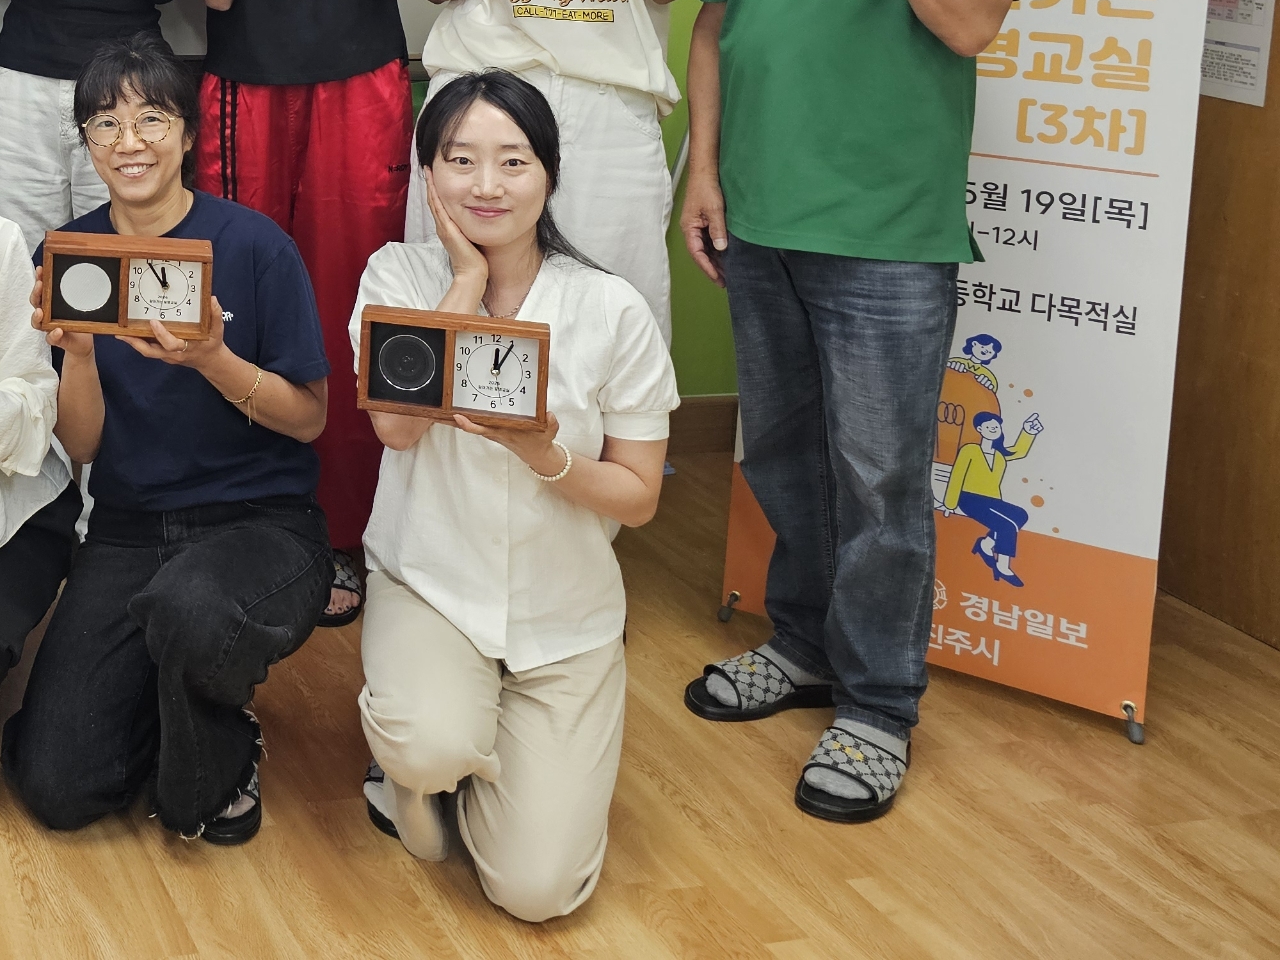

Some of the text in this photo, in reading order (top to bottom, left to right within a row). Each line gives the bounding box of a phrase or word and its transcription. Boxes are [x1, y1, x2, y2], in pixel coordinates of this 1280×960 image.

[976, 27, 1153, 92] 명교실
[1016, 97, 1148, 156] [3차]
[1020, 188, 1150, 231] 19일[목]
[970, 221, 1039, 251] -12시
[186, 298, 192, 306] 4
[144, 307, 150, 315] 7
[956, 279, 1138, 336] 등학교 다목적실
[473, 335, 483, 344] 11
[490, 334, 502, 343] 12
[460, 347, 471, 355] 10
[522, 354, 529, 362] 2
[456, 363, 462, 371] 9
[525, 371, 532, 379] 3
[461, 379, 467, 388] 8
[519, 386, 526, 394] 4
[508, 398, 515, 406] 5
[960, 591, 1089, 649] 경남일보
[928, 623, 1001, 666] 진주시
